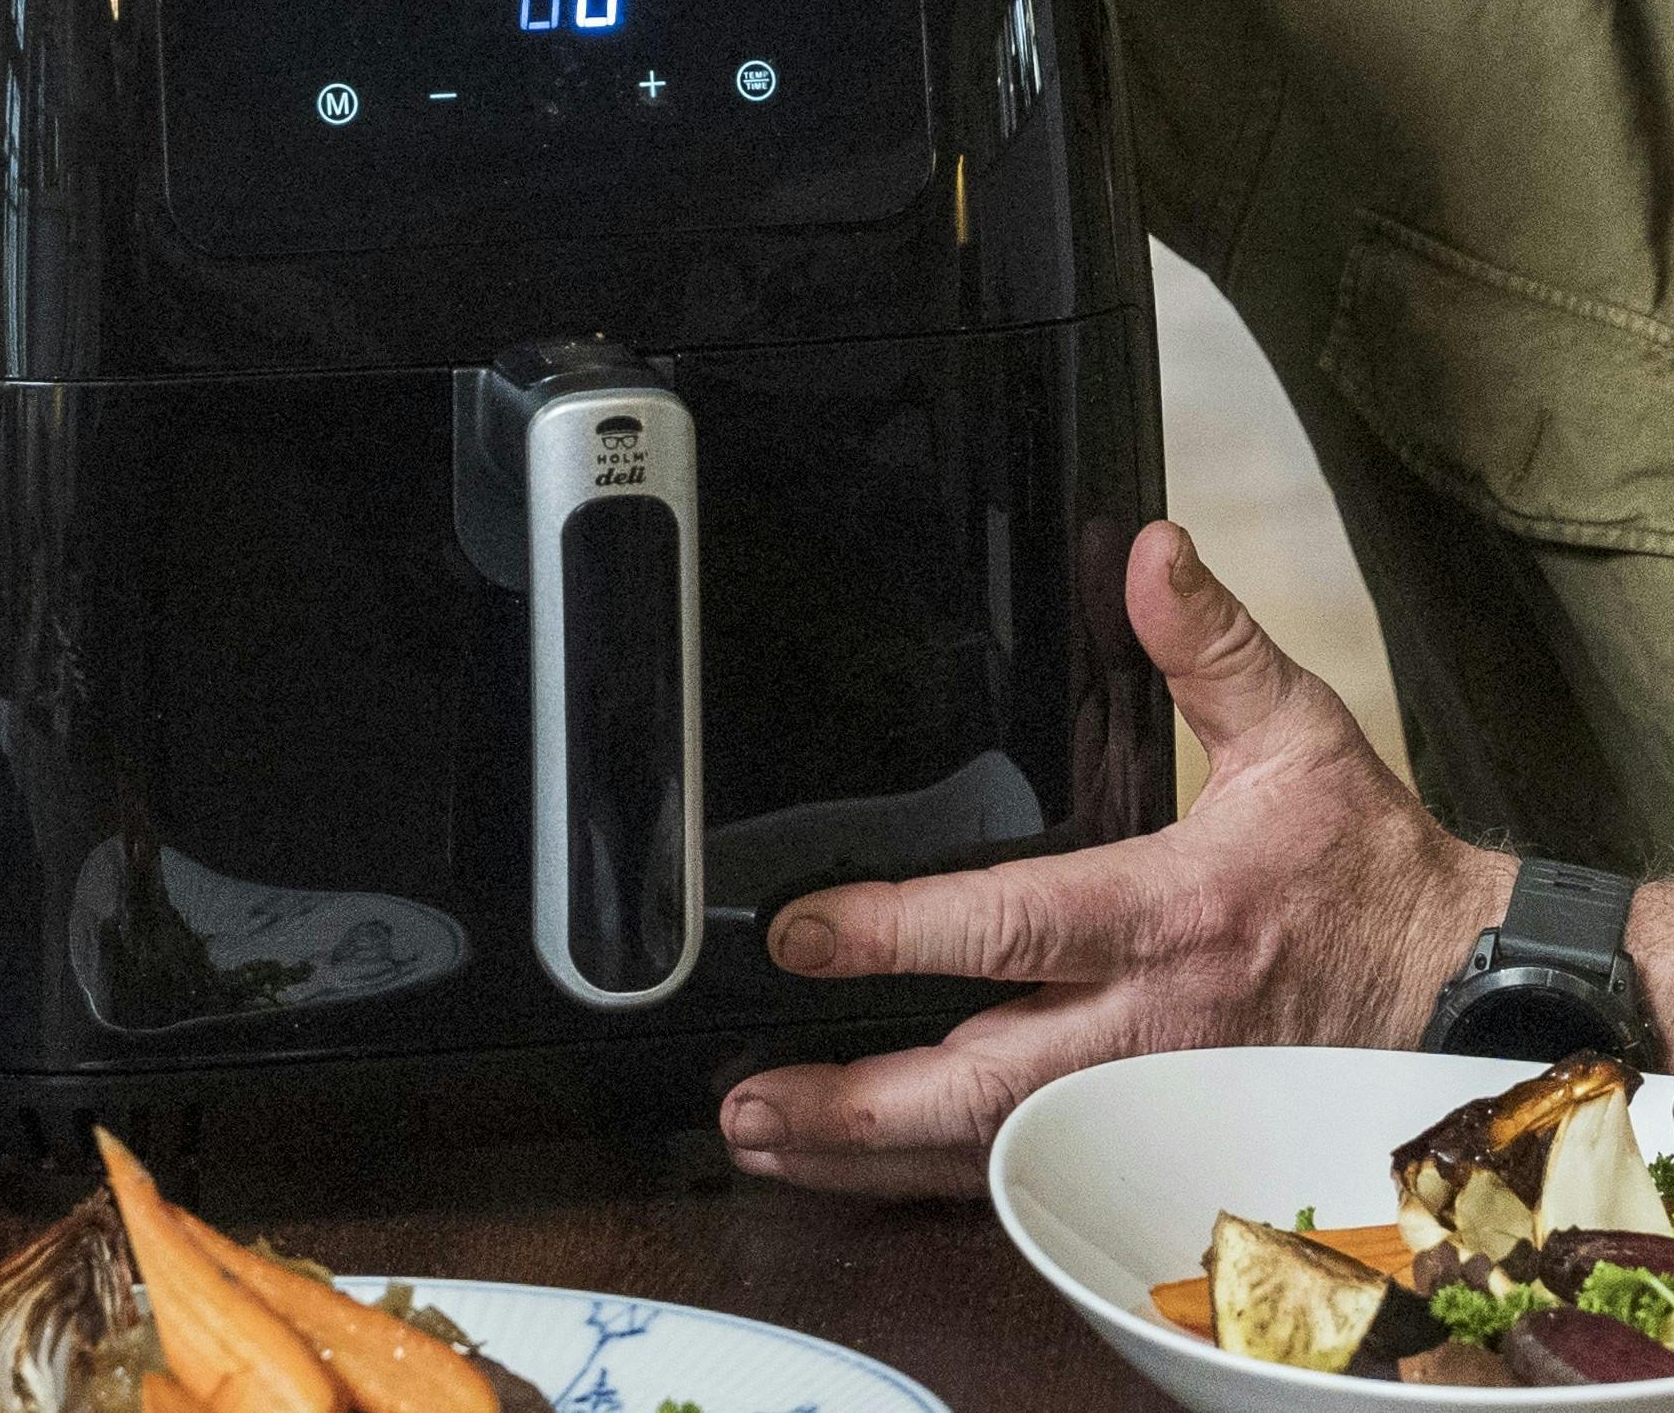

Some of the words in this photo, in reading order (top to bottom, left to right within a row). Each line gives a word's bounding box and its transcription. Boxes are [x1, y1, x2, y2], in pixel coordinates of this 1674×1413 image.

[743, 70, 769, 79] TEMP
[746, 82, 768, 91] TIME
[326, 91, 350, 116] M
[595, 465, 647, 487] deli
